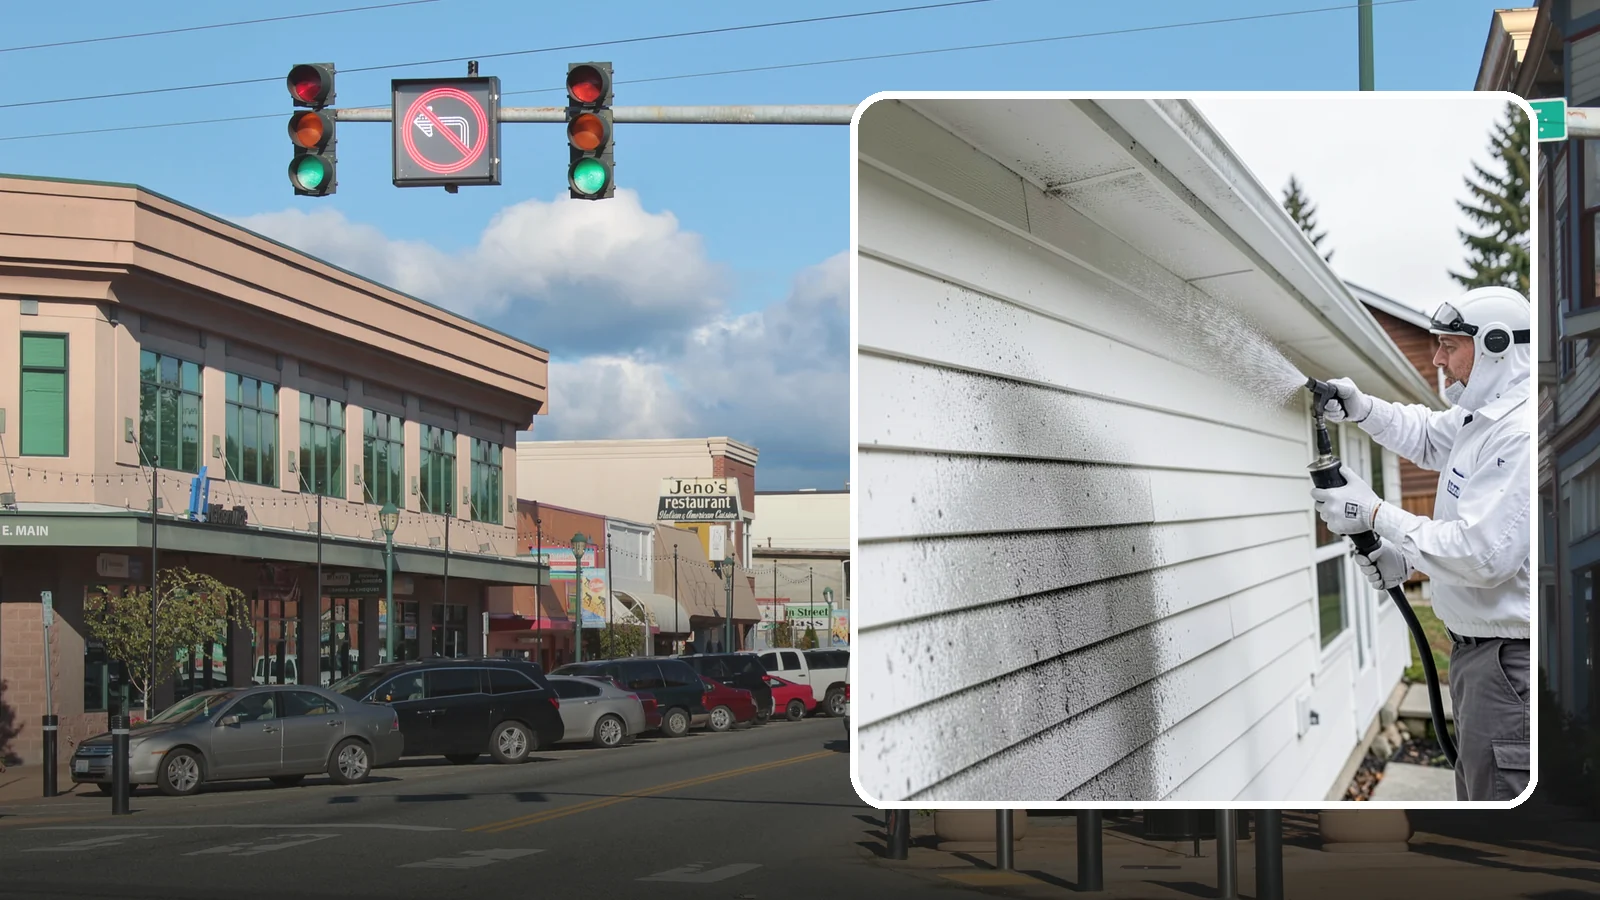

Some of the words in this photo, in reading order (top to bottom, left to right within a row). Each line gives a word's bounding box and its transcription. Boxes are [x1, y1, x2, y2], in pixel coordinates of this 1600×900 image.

[669, 480, 727, 494] Jeno's
[665, 496, 731, 509] restaurant
[659, 510, 681, 519] Italian
[686, 510, 714, 519] American
[715, 510, 737, 519] Cuisine
[2, 525, 13, 536] E.
[15, 525, 49, 536] MAIN
[785, 607, 795, 617] in
[797, 607, 828, 617] Street
[791, 619, 823, 627] lass
